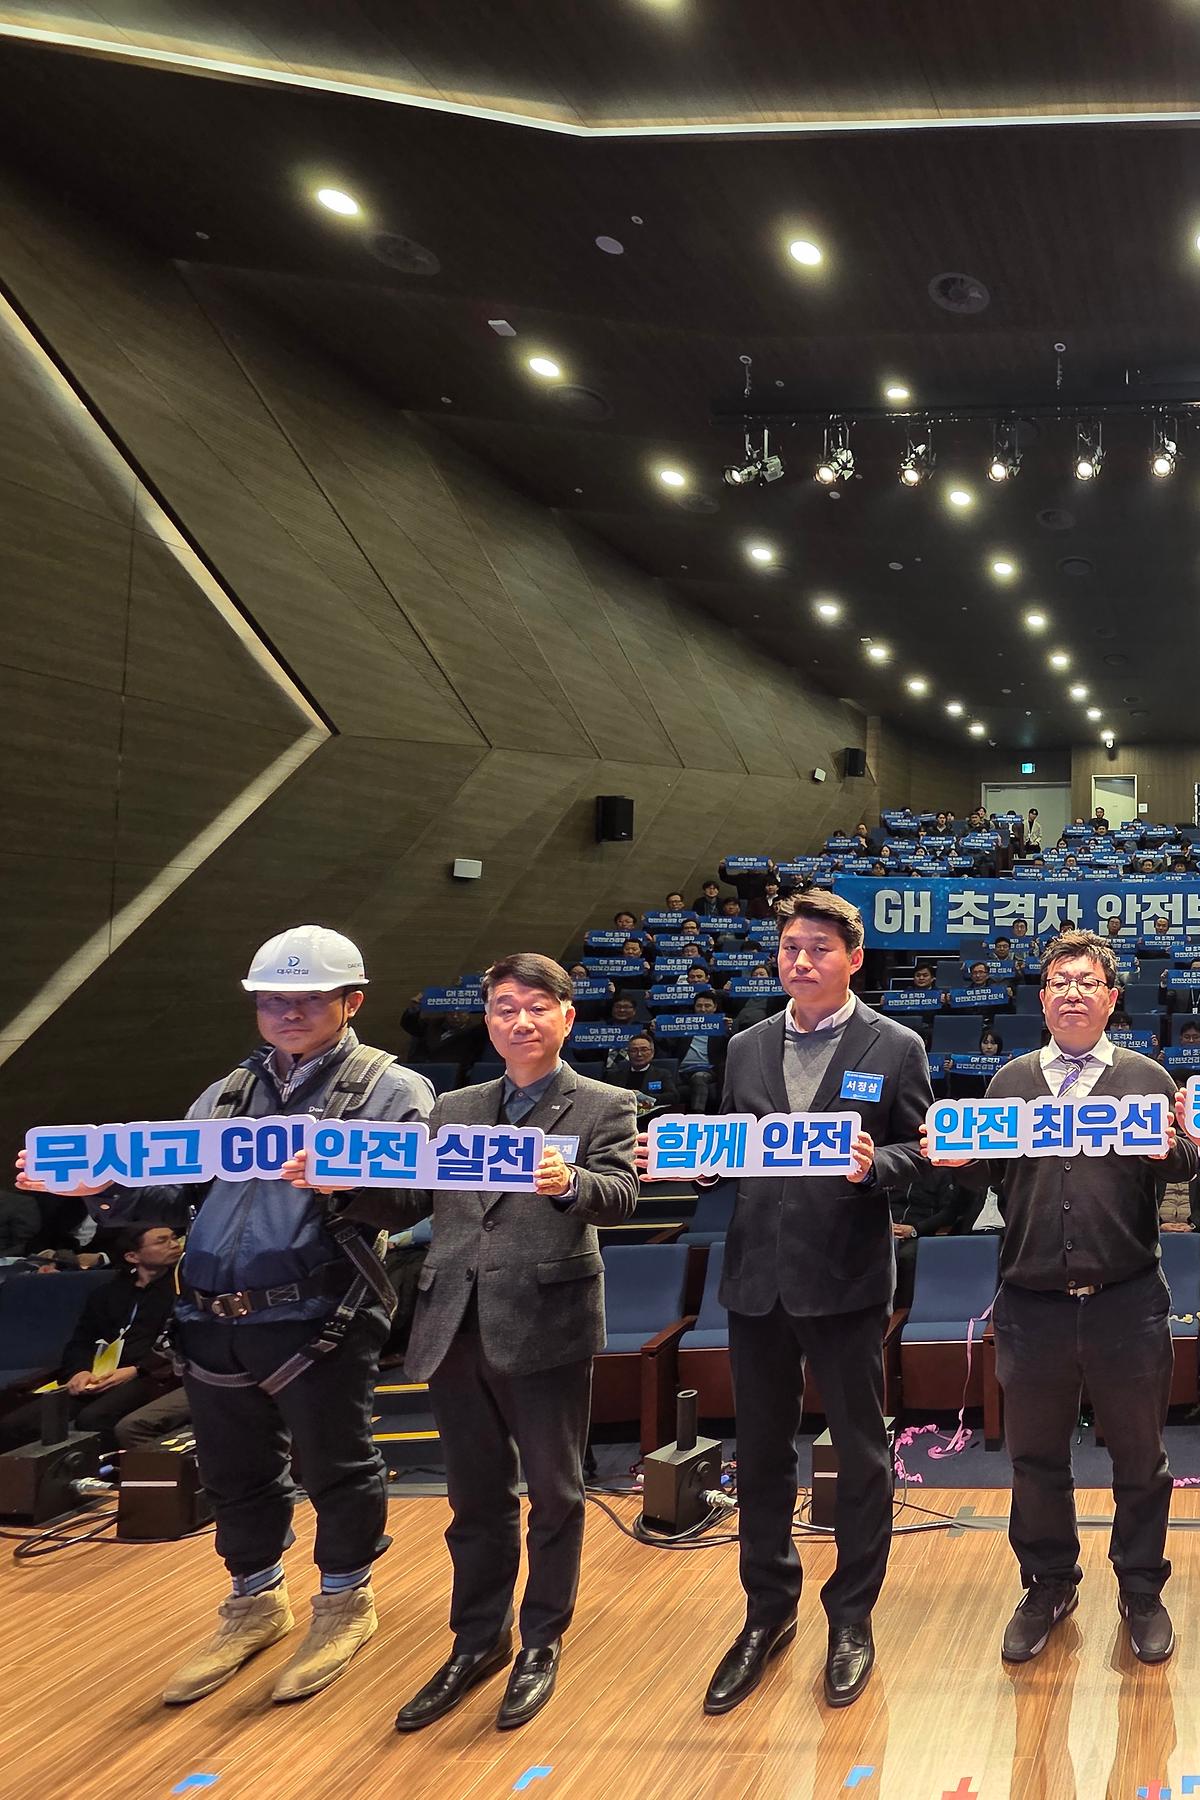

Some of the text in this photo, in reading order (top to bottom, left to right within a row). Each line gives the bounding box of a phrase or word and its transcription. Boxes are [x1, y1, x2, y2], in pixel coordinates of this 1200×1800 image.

[874, 889, 931, 933] GH
[946, 890, 1084, 936] 초격차
[846, 1080, 877, 1093] 서정삼
[655, 1120, 853, 1169] 함께 안전
[933, 1102, 1163, 1151] 안전 최우선
[36, 1128, 203, 1182] 무사고
[315, 1129, 535, 1184] 안전 실천
